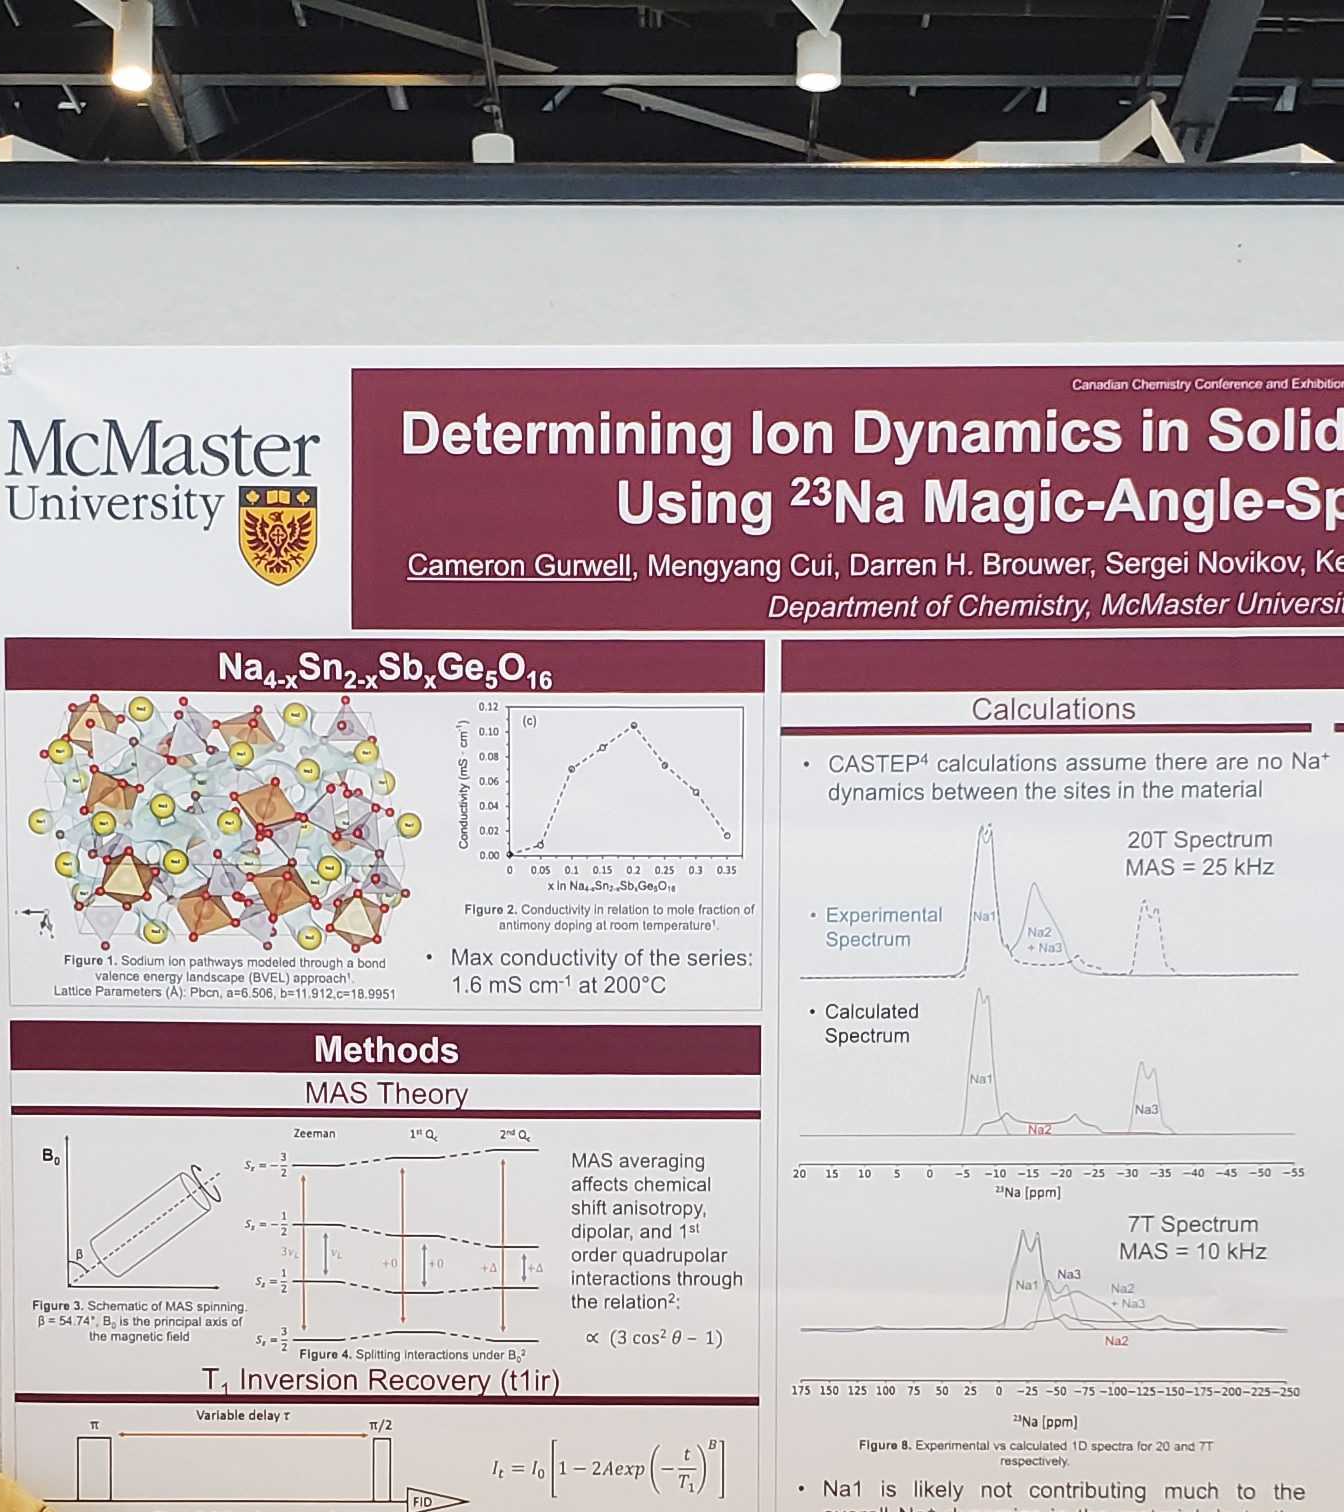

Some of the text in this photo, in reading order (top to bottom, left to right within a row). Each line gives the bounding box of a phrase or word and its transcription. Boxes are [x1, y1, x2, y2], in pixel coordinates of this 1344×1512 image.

[1072, 378, 1129, 391] Canadian
[1131, 378, 1192, 393] Chemistry
[1194, 378, 1263, 391] Conference
[1265, 378, 1289, 389] and
[4, 418, 321, 478] McMaster
[403, 410, 732, 468] Determining
[752, 410, 833, 455] Ion
[854, 409, 1123, 466] Dynamics
[1142, 408, 1189, 453] in
[4, 484, 226, 532] University
[617, 479, 772, 536] Using
[406, 552, 527, 580] Cameron
[533, 552, 638, 580] Gurwell,
[648, 553, 781, 582] Mengyang
[790, 553, 840, 580] Cui,
[850, 553, 937, 577] Darren
[945, 552, 973, 577] H.
[983, 552, 1096, 579] Brouwer,
[1104, 550, 1190, 580] Sergei
[1198, 549, 1306, 577] Novikov,
[768, 595, 919, 622] Department
[925, 594, 954, 618] of
[958, 593, 1091, 621] Chemistry,
[1100, 591, 1231, 617] McMaster
[972, 696, 1136, 721] Calculations
[828, 779, 1263, 806] dynamics between the sites in the material
[826, 906, 943, 928] Experimental
[825, 931, 911, 951] Spectrum
[315, 1035, 459, 1064] Methods
[306, 1081, 469, 1107] MAS Theory
[241, 1367, 358, 1391] Inversion
[369, 1368, 491, 1395] Recovery
[501, 1368, 560, 1395] (t1ir)
